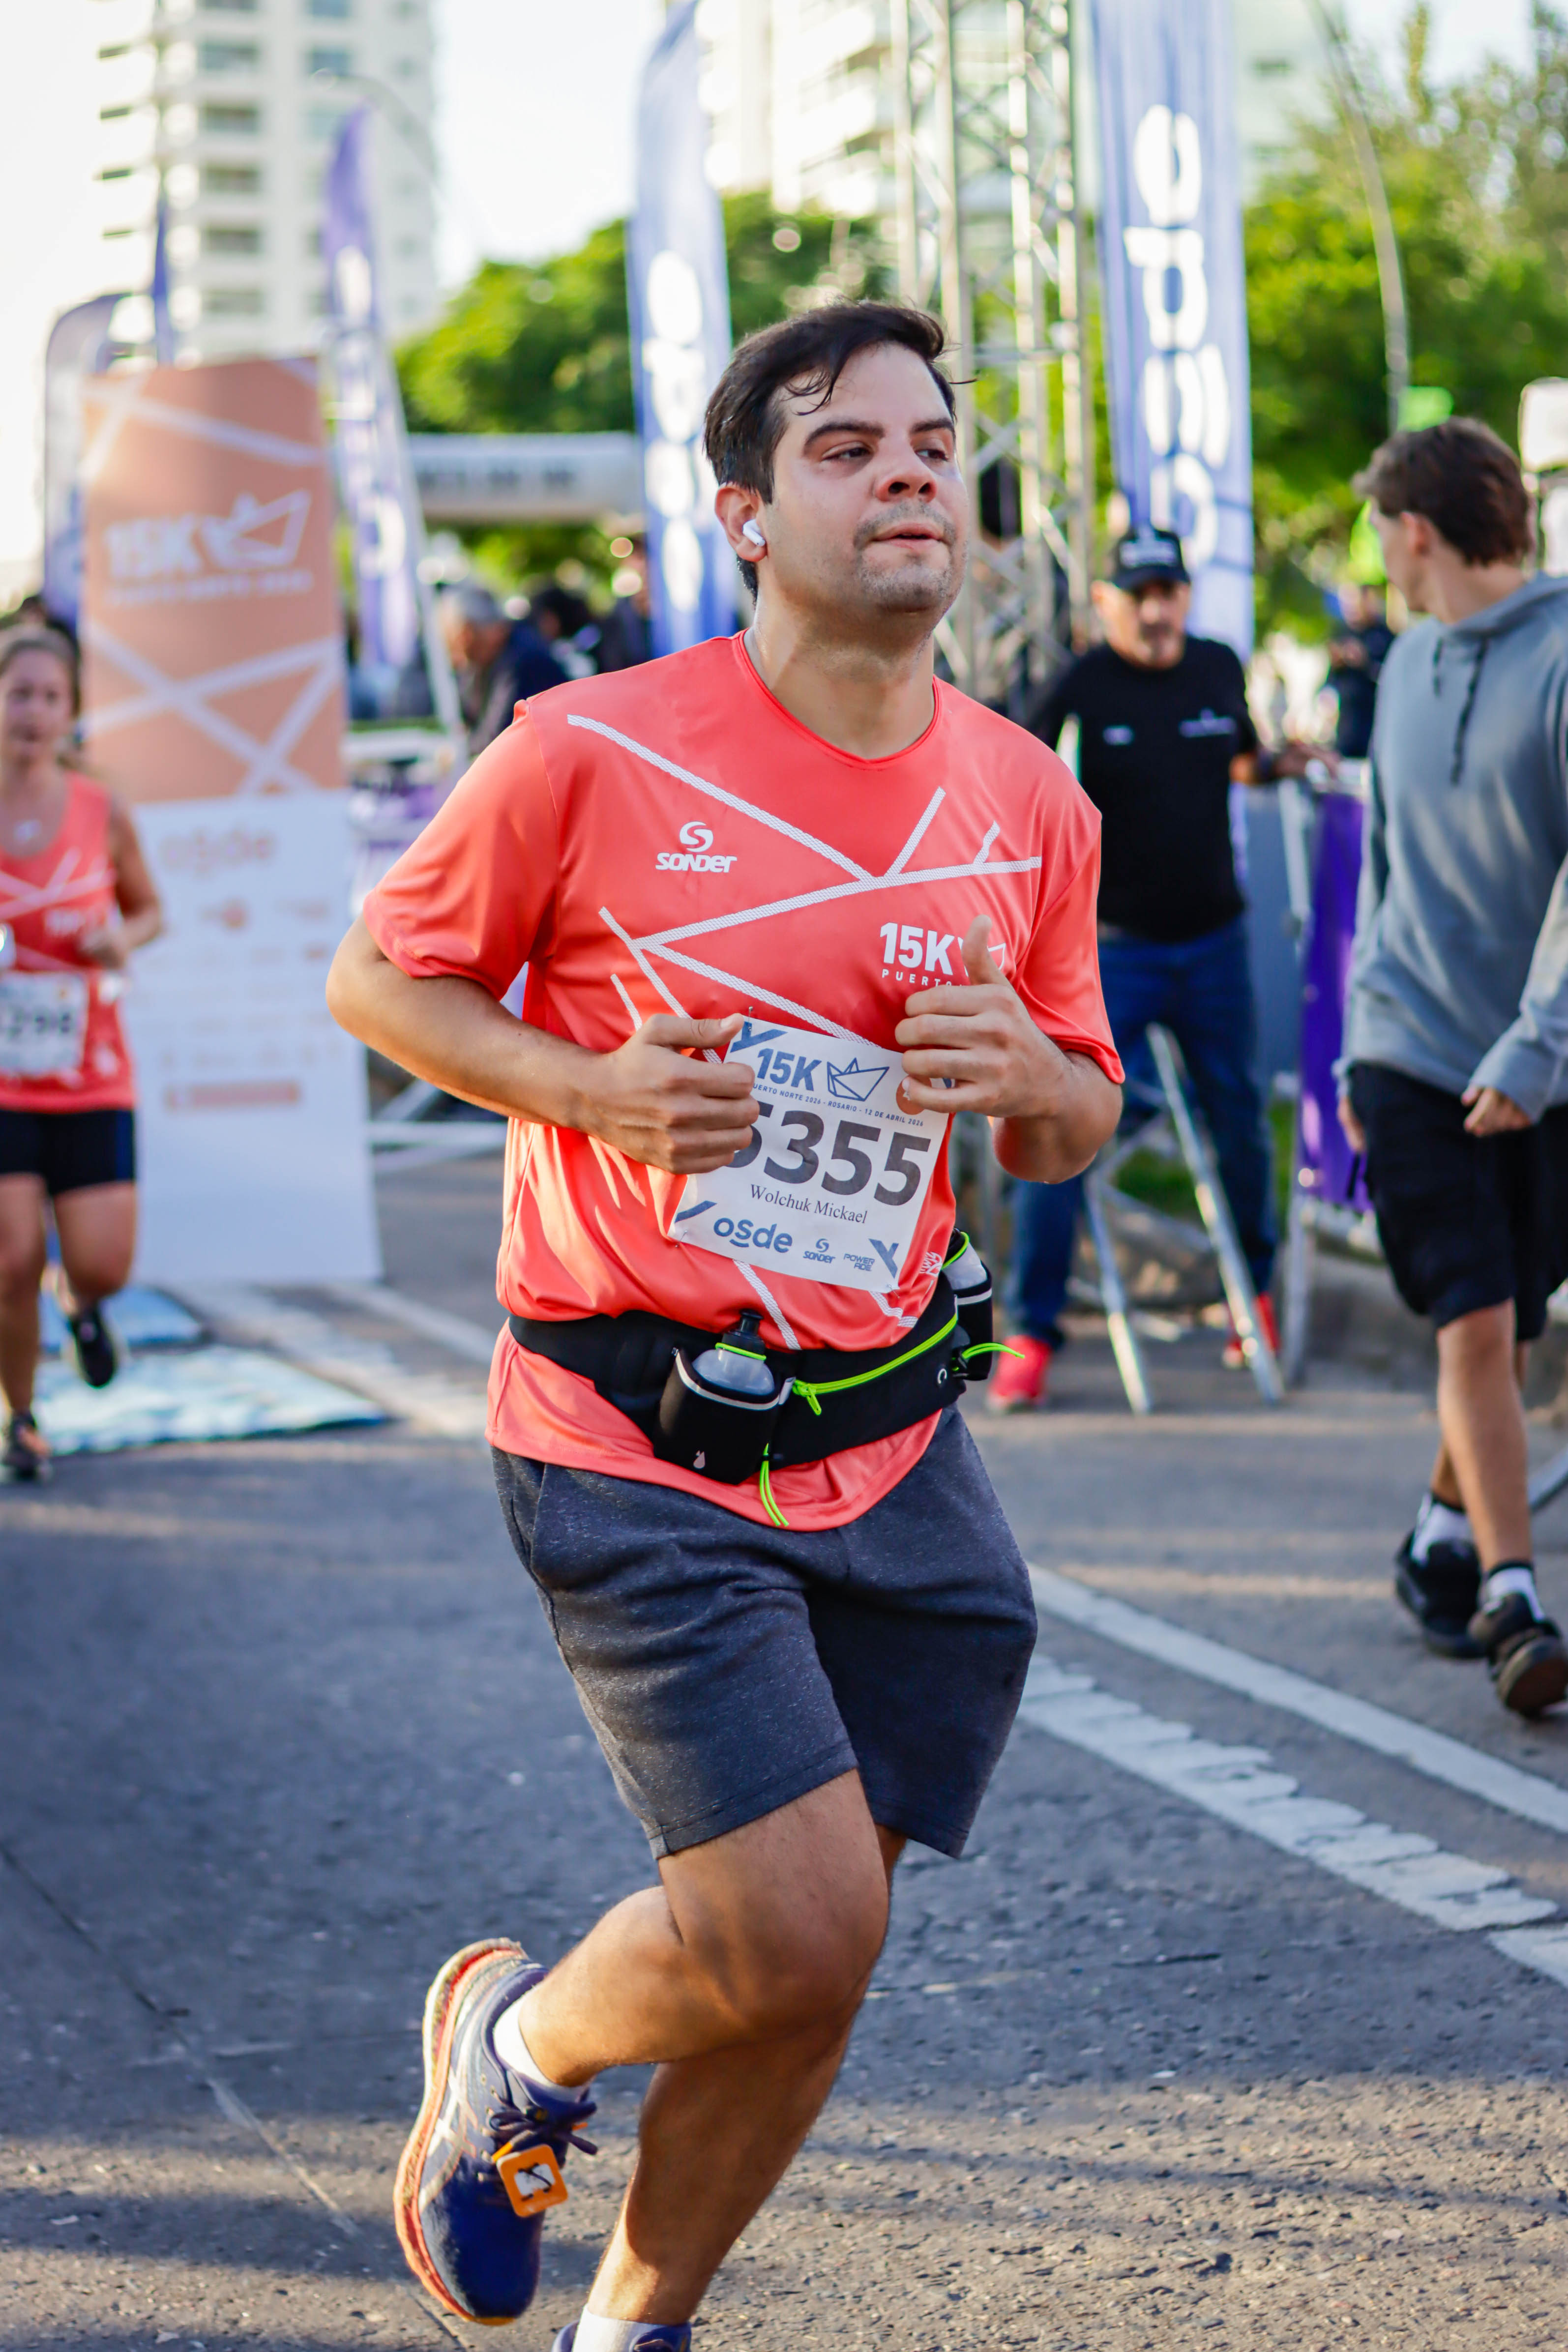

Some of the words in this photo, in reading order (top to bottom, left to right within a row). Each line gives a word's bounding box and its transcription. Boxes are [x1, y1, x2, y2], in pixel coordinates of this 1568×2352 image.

[880, 922, 955, 976] 15K
[757, 1048, 822, 1091] 15K
[753, 1083, 777, 1094] UERTO
[779, 1090, 803, 1101] NORTE
[805, 1096, 821, 1105] 2026
[828, 1101, 857, 1112] ROSARIO
[886, 1114, 905, 1123] ABRIL
[751, 1184, 811, 1212] Wolchuk
[814, 1201, 868, 1224] Mickael
[713, 1217, 793, 1253] osde
[843, 1253, 875, 1265] POWER
